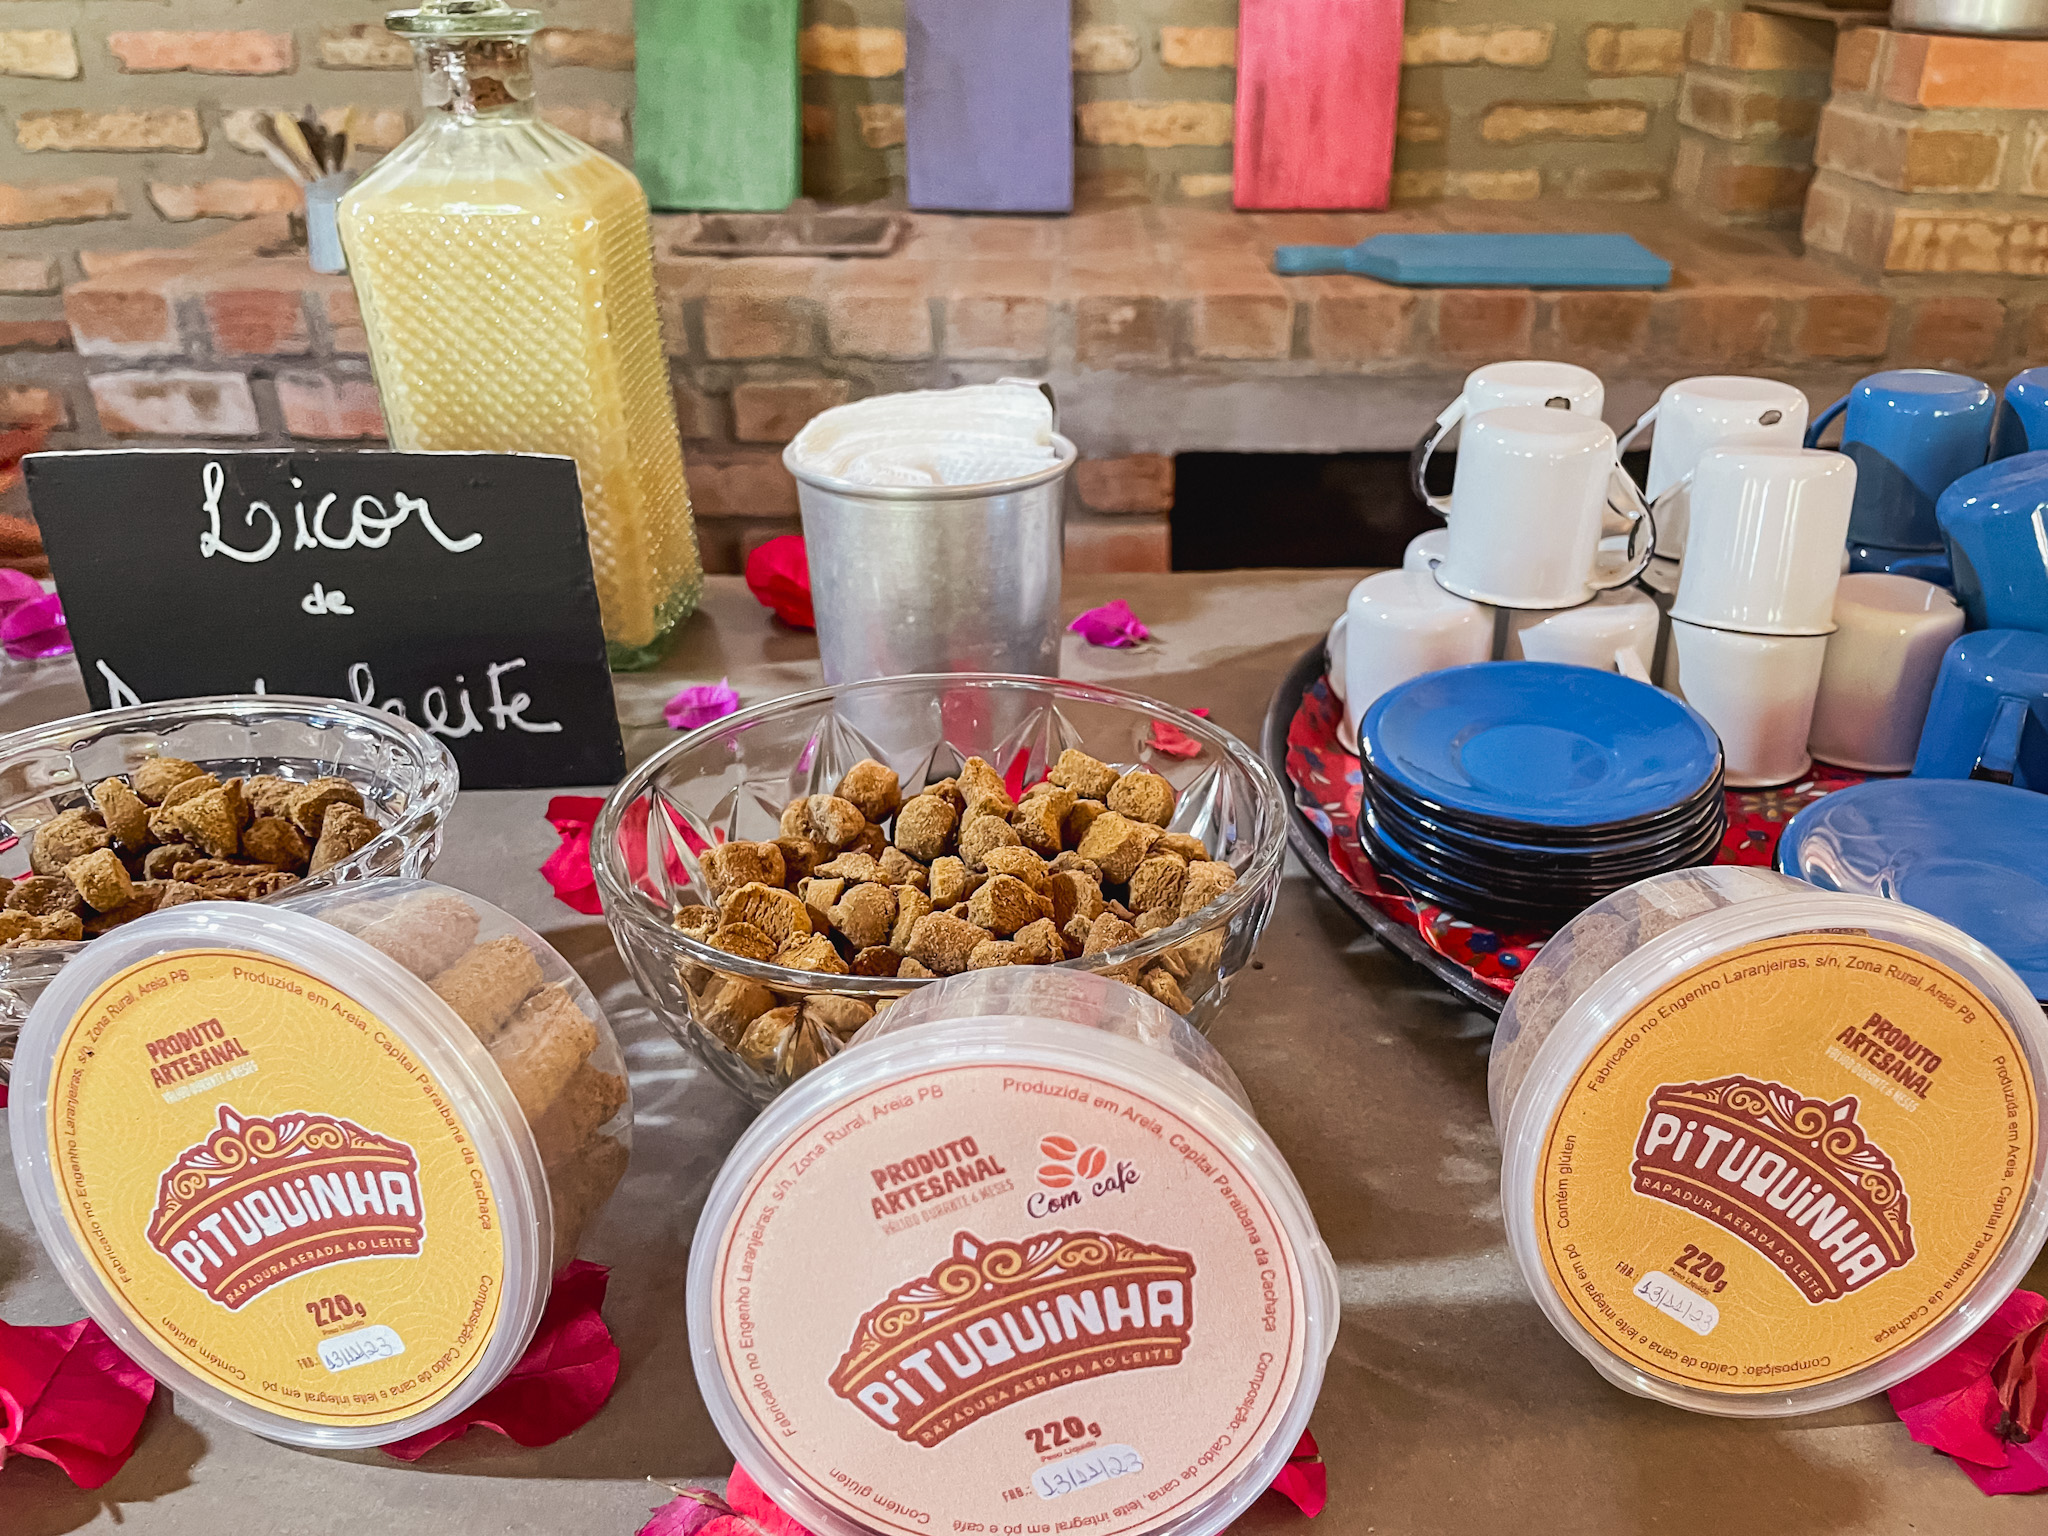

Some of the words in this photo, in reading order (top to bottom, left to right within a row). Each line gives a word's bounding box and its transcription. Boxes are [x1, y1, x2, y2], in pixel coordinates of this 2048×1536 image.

[200, 461, 483, 563] Licor
[302, 582, 355, 615] de
[138, 976, 168, 997] Areia
[169, 969, 190, 984] PB
[85, 1015, 110, 1043] Zona
[1587, 1032, 1640, 1093] Fabricado
[1640, 1017, 1658, 1034] no
[1657, 979, 1721, 1019] Engenho
[1723, 956, 1810, 984] Laranjeiras,
[1815, 955, 1841, 968] s/n,
[1845, 955, 1882, 974] Zona
[1884, 964, 1924, 991] Rural,
[1924, 984, 1957, 1009] Areia
[1955, 1005, 1977, 1024] PB
[145, 1018, 225, 1064] PRODUTO
[1861, 1012, 1943, 1074] PRODUTO
[150, 1037, 250, 1089] ARTESANAL
[1836, 1025, 1934, 1100] ARTESANAL
[233, 966, 302, 995] Produzida
[307, 991, 328, 1007] em
[331, 1002, 369, 1035] Areia,
[374, 1031, 418, 1074] Capital
[416, 1074, 465, 1143] Paraibana
[461, 1147, 474, 1165] da
[470, 1169, 491, 1230] Cachaça
[918, 1085, 943, 1103] PB
[1003, 1077, 1089, 1103] Produzida
[1992, 1055, 2020, 1118] Produzida
[873, 1094, 914, 1120] Areia
[1093, 1097, 1119, 1114] em
[824, 1114, 871, 1145] Rural,
[1122, 1106, 1164, 1138] Areia,
[2008, 1121, 2019, 1141] em
[65, 1139, 87, 1197] Engenho
[789, 1143, 825, 1176] Zona
[871, 1135, 980, 1191] PRODUTO
[1169, 1133, 1219, 1178] Capital
[1558, 1134, 1577, 1175] glúten
[2001, 1142, 2021, 1181] Areia,
[772, 1178, 797, 1201] s/n,
[871, 1154, 1006, 1220] ARTESANAL
[1027, 1190, 1082, 1219] Com
[1092, 1161, 1140, 1197] café
[82, 1201, 95, 1219] no
[1213, 1175, 1261, 1245] Paraibana
[1555, 1179, 1570, 1229] Contém
[1985, 1186, 2012, 1230] Capital
[1563, 1243, 1580, 1259] pó
[1641, 1177, 1722, 1216] RAPADURA
[1723, 1212, 1776, 1250] AERADA
[1775, 1248, 1794, 1265] AO
[1793, 1263, 1824, 1298] LEITE
[91, 1221, 132, 1283] Fabricado
[1254, 1247, 1270, 1266] da
[1943, 1232, 1993, 1290] Paraibana
[225, 1261, 288, 1304] RAPADURA
[290, 1246, 344, 1267] AERADA
[347, 1241, 367, 1251] AO
[373, 1238, 413, 1249] LEITE
[1572, 1261, 1588, 1280] em
[1260, 1270, 1279, 1333] Cachaça
[1580, 1281, 1617, 1322] integral
[1928, 1290, 1944, 1305] da
[736, 1286, 755, 1349] Engenho
[1615, 1318, 1639, 1340] leite
[1874, 1305, 1929, 1343] Cachaça
[1639, 1335, 1648, 1344] e
[1648, 1341, 1678, 1360] cana
[200, 1348, 246, 1381] Contém
[431, 1347, 460, 1373] Caldo
[746, 1352, 761, 1369] no
[1680, 1355, 1698, 1368] de
[1700, 1360, 1739, 1377] Caldo
[1742, 1355, 1831, 1377] Composição:
[262, 1380, 278, 1392] pó
[389, 1379, 417, 1396] cana
[417, 1370, 432, 1383] de
[282, 1386, 300, 1399] em
[304, 1391, 351, 1406] integral
[353, 1391, 379, 1404] leite
[380, 1389, 388, 1399] e
[754, 1374, 798, 1438] Fabricado
[921, 1390, 1009, 1443] RAPADURA
[1014, 1364, 1084, 1395] AERADA
[1091, 1356, 1116, 1371] AO
[1122, 1348, 1174, 1364] LEITE
[1198, 1435, 1232, 1466] Caldo
[829, 1467, 873, 1497] glúten
[1181, 1465, 1198, 1480] de
[1143, 1479, 1180, 1501] cana,
[873, 1492, 931, 1525] Contém
[1112, 1499, 1144, 1517] leite
[952, 1520, 985, 1533] café
[989, 1524, 998, 1533] e
[1004, 1524, 1022, 1536] pó
[1027, 1523, 1050, 1534] em
[1055, 1514, 1110, 1533] integral
